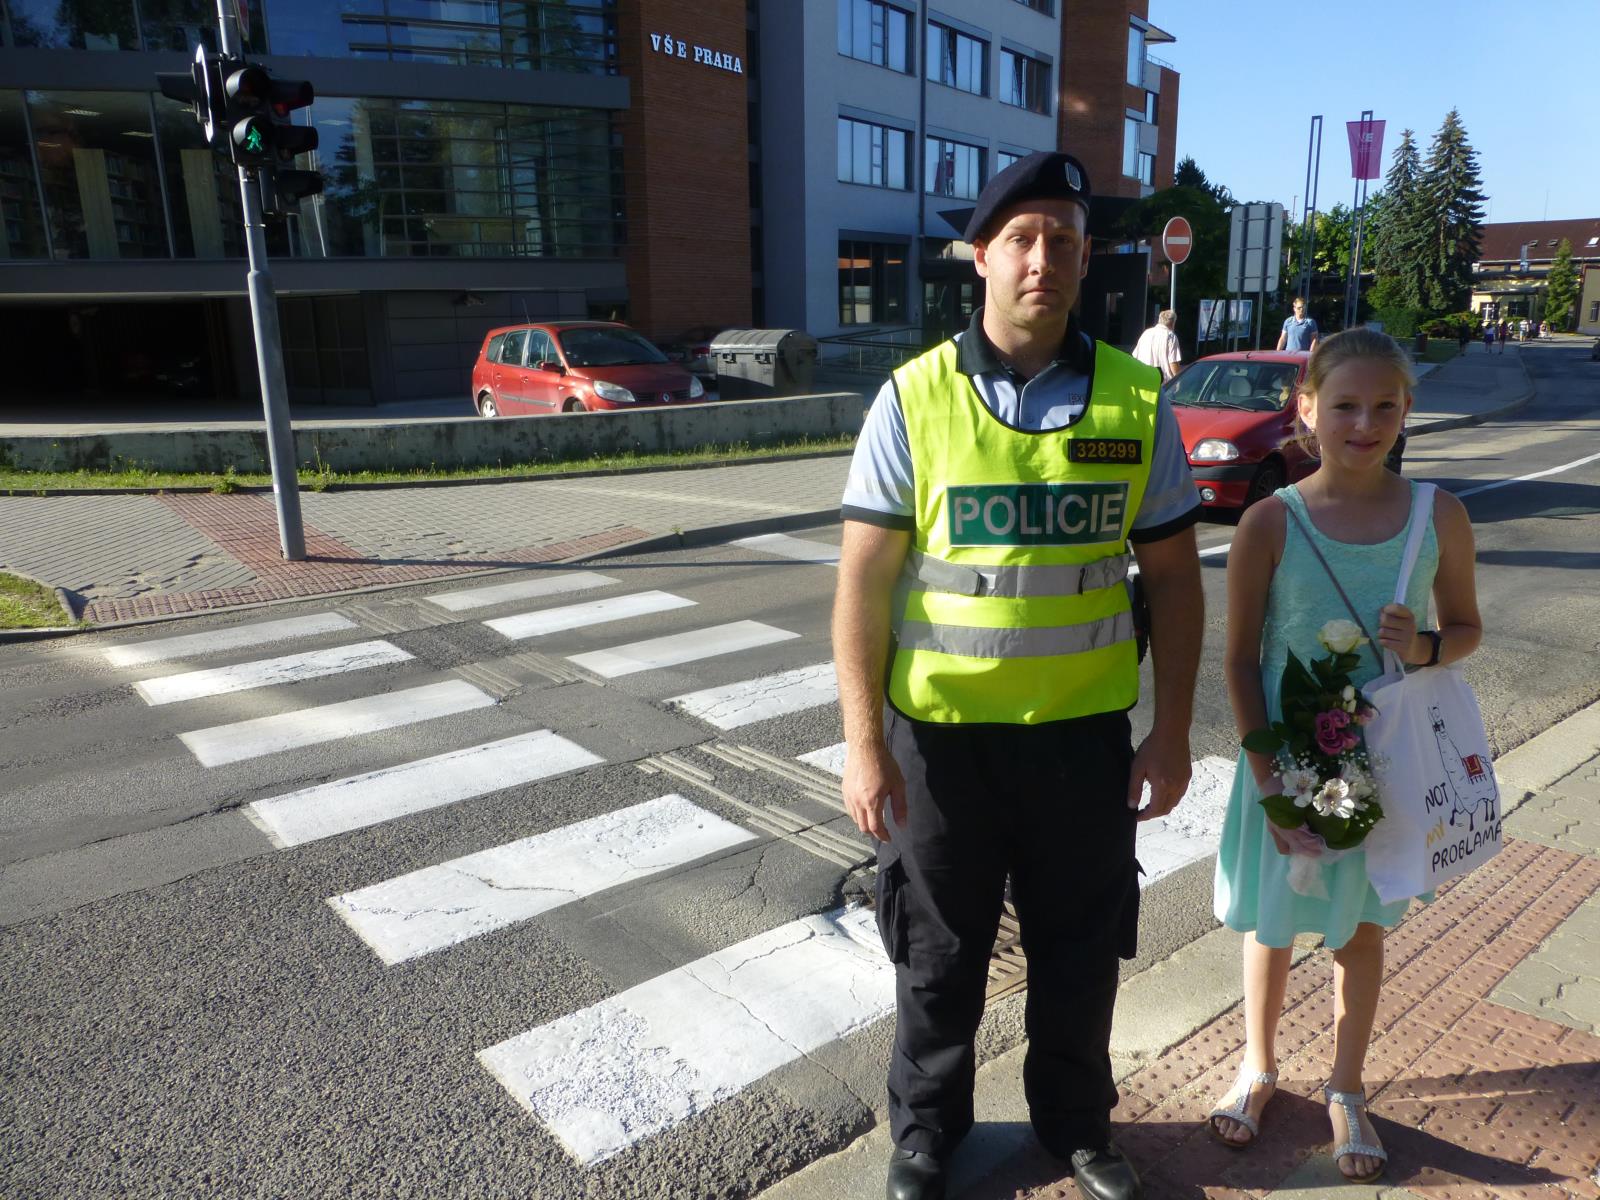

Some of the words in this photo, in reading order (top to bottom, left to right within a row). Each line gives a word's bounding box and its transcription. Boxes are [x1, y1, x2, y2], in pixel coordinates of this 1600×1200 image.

[651, 33, 687, 58] VŠE
[693, 46, 743, 73] PRAHA
[1077, 442, 1137, 458] 328299
[953, 493, 1124, 536] POLICIE
[1425, 782, 1449, 814] NOT
